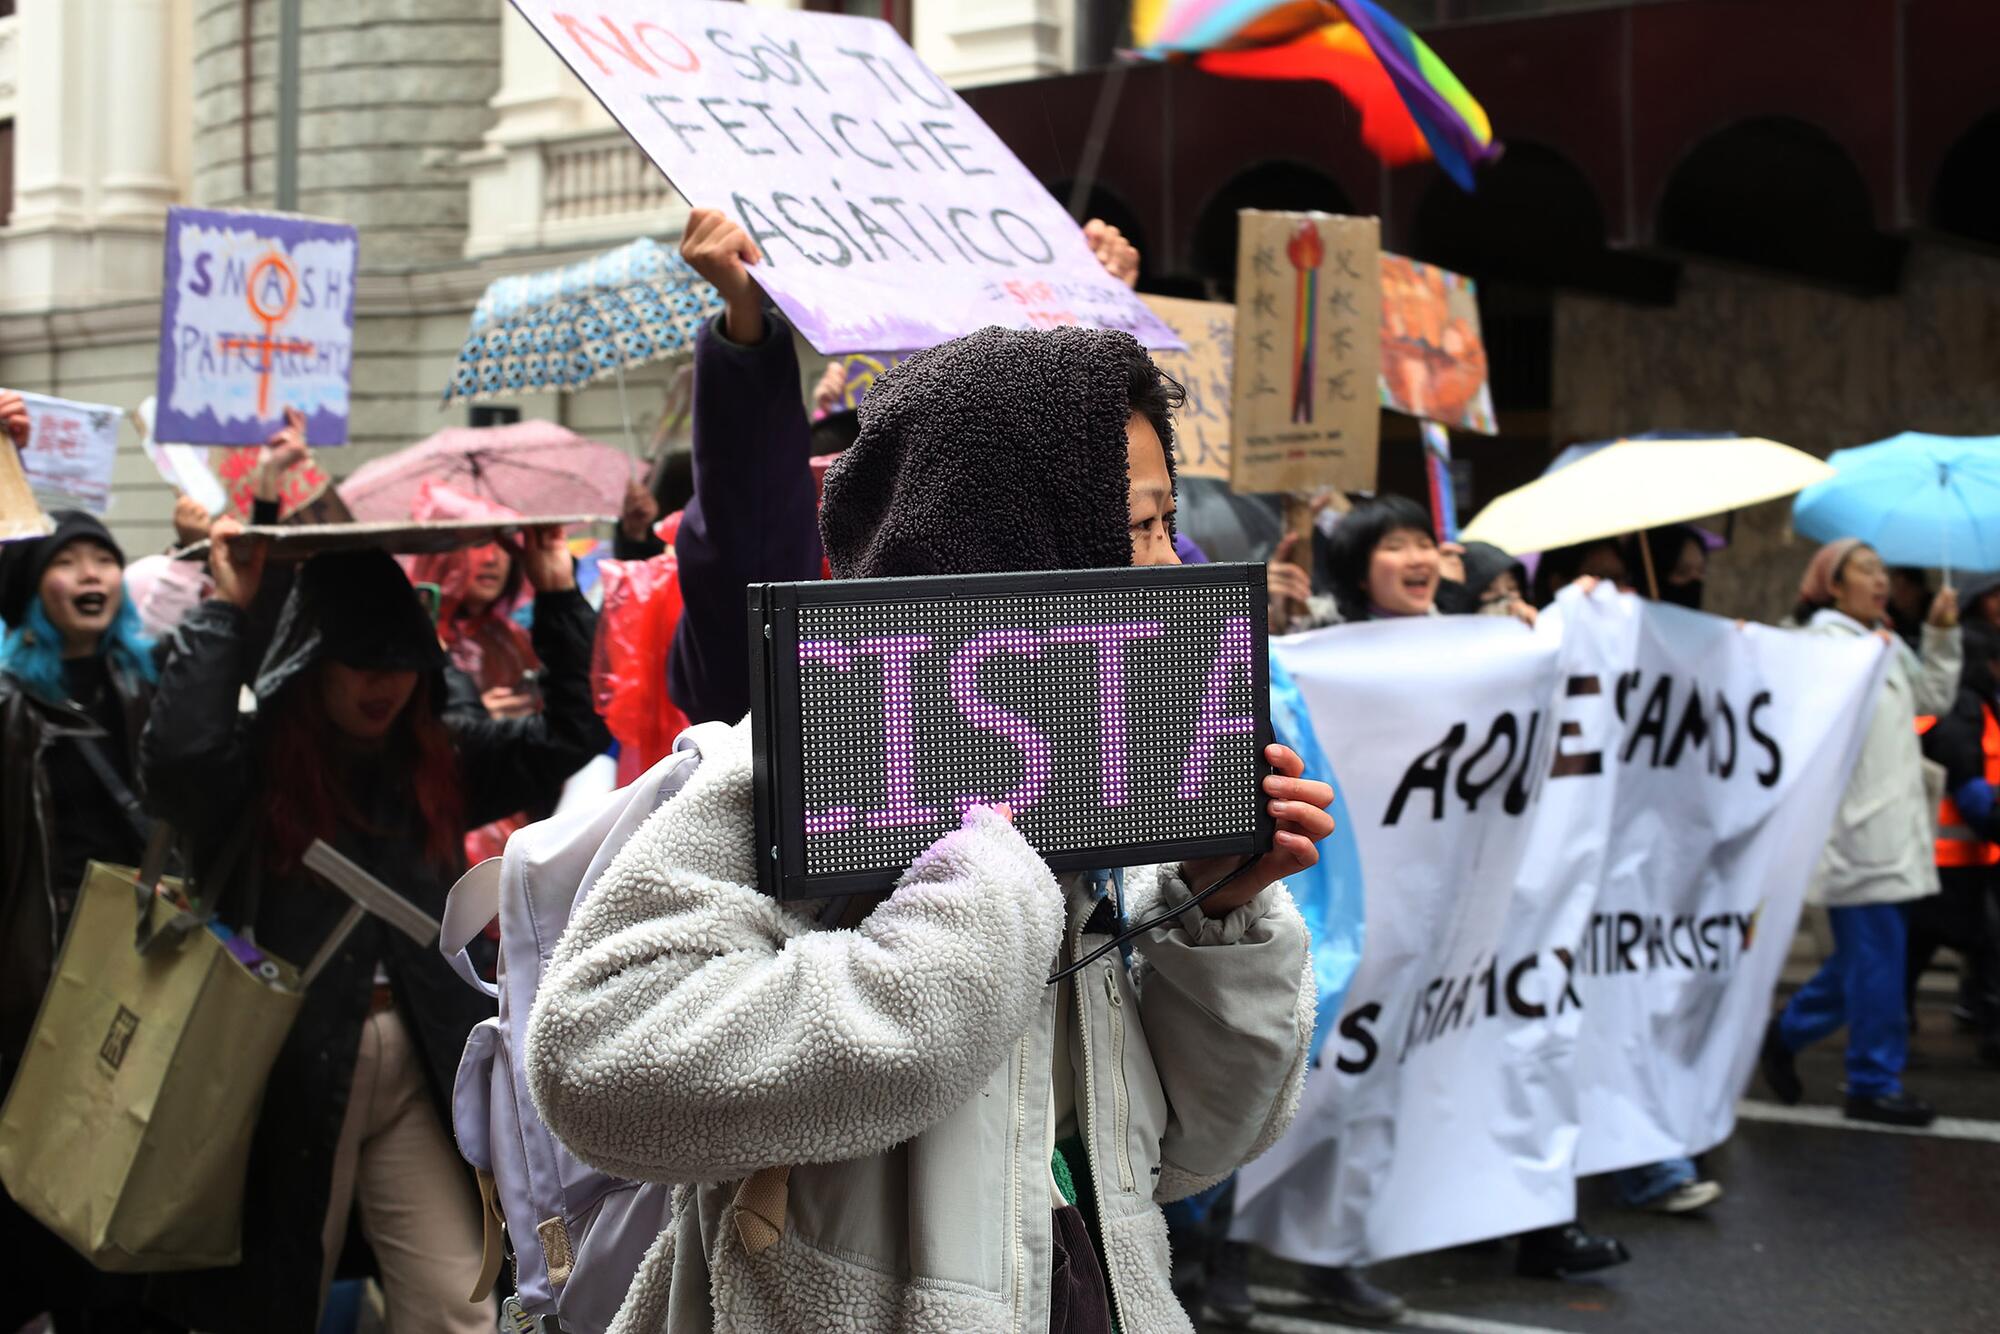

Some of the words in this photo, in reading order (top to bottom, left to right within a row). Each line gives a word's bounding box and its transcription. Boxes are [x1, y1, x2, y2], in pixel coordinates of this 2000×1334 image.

[553, 12, 700, 78] NO
[705, 28, 829, 95] SOY
[836, 47, 955, 111] TU
[642, 94, 996, 176] FETICHE
[730, 178, 1055, 268] ASIÁTICO
[187, 252, 341, 309] SMASH
